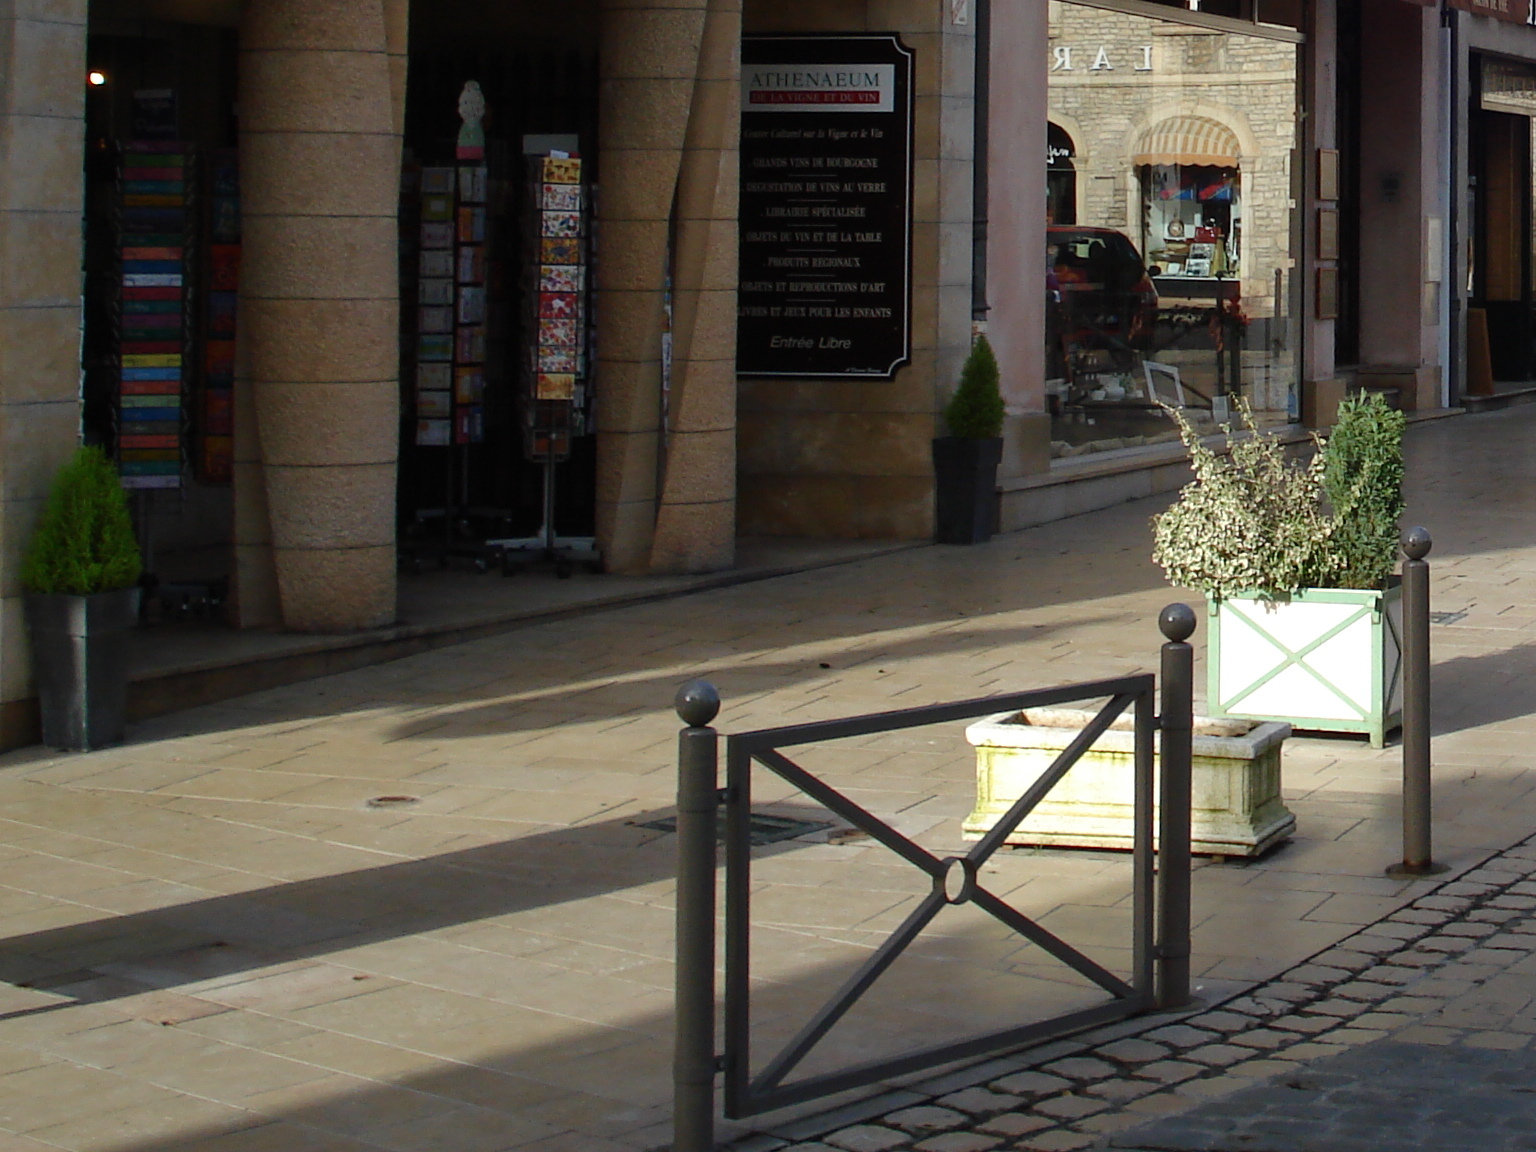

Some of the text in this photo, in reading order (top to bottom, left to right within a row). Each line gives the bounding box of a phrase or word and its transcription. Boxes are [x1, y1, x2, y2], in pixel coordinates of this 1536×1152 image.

[751, 71, 880, 87] ATHENAEUM
[771, 93, 783, 102] LA
[788, 93, 820, 102] VIGNE
[824, 93, 835, 102] ET
[840, 93, 854, 102] DU
[858, 93, 877, 102] VIN
[753, 157, 878, 168] GRANDS VINS DE BOURGOGNE
[806, 182, 817, 192] DE
[820, 182, 840, 192] VINS
[842, 182, 854, 192] AU
[858, 182, 886, 192] VERRE
[746, 232, 882, 242] OBJETS DU VIN ET DE LA TABLE
[768, 257, 809, 268] PRODUITS
[776, 281, 786, 292] ET
[789, 281, 858, 292] REPRODUCTIONS
[860, 282, 885, 292] D'ART
[771, 306, 782, 317] ET
[785, 306, 806, 317] JEUX
[809, 307, 832, 317] POUR
[835, 307, 851, 317] LES
[853, 307, 891, 318] ENFANTS
[770, 335, 852, 349] Entrée Libre
